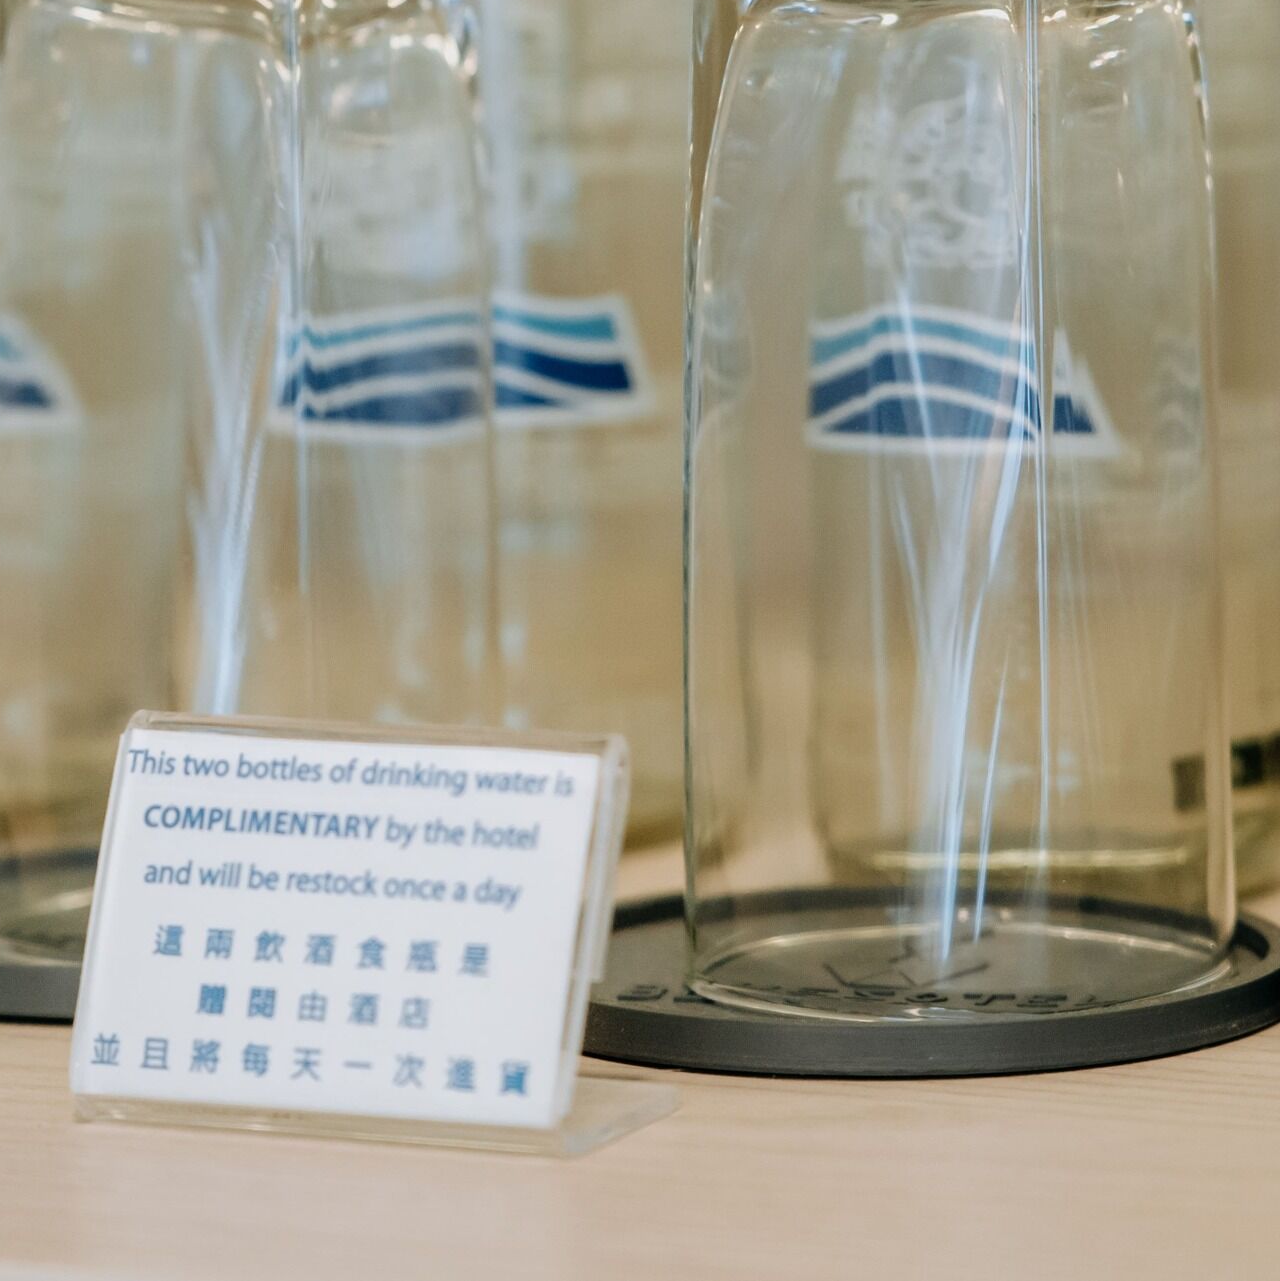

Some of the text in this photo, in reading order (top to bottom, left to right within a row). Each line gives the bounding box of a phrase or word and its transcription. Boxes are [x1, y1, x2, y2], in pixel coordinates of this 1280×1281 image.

[128, 748, 575, 797] This two bottles of drinking water is
[144, 803, 541, 850] COMPLIMENTARY by the hotel
[143, 860, 521, 912] and will be restock once a day
